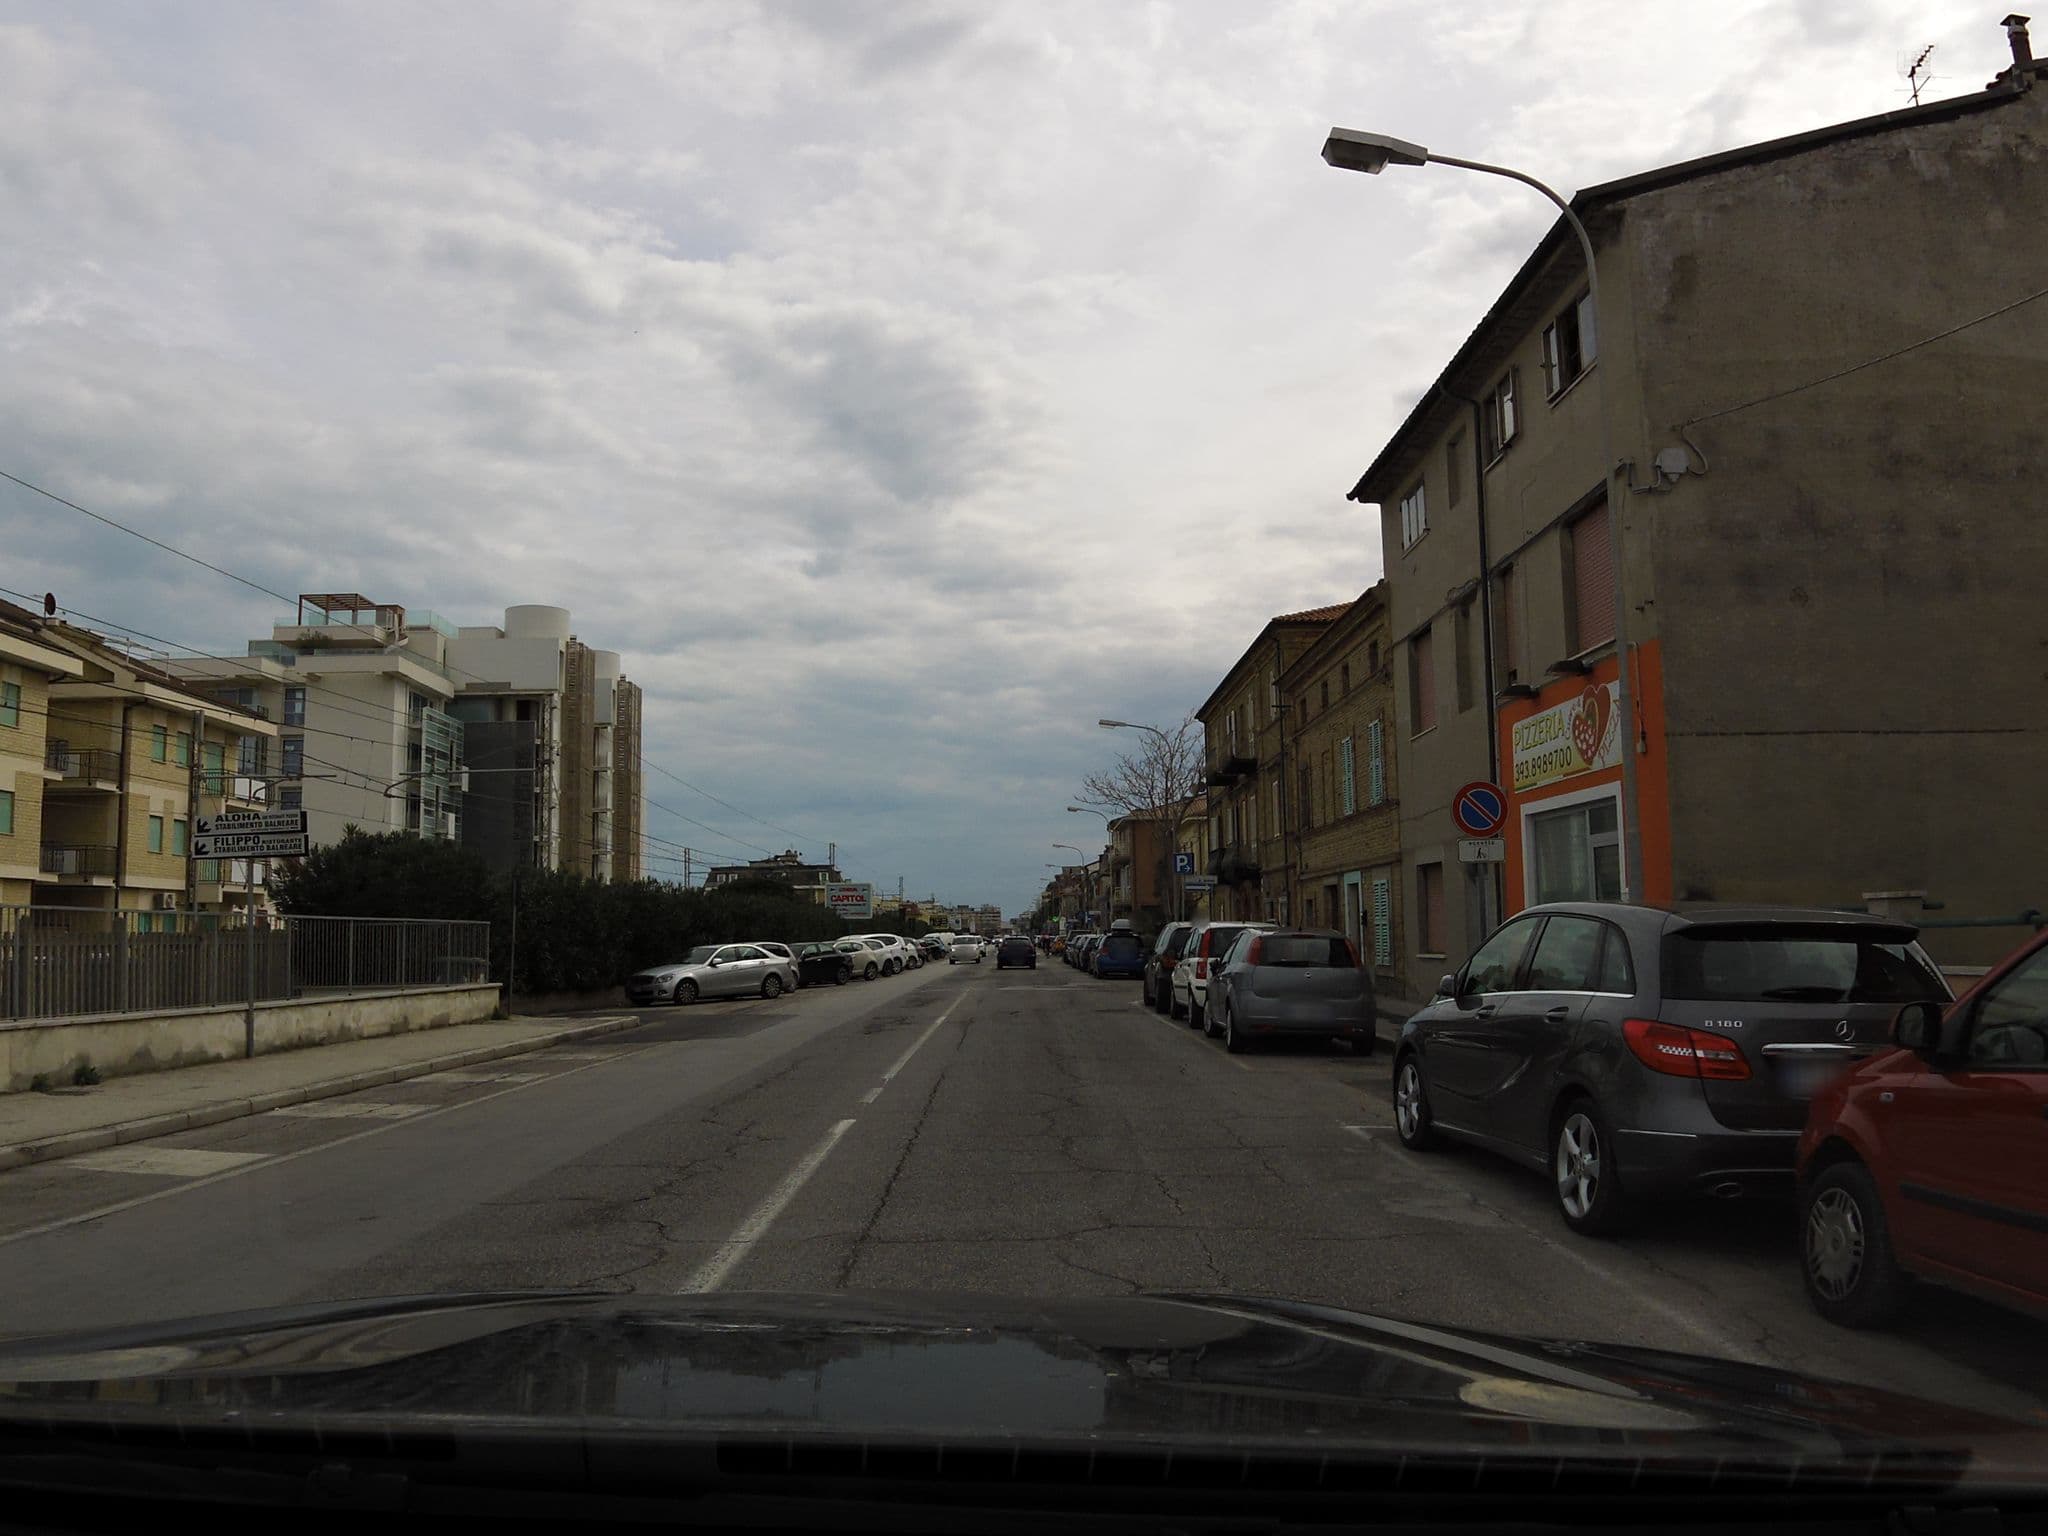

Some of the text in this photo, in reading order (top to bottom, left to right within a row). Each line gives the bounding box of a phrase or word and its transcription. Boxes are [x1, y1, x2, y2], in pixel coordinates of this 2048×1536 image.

[1514, 709, 1565, 753] PIZZERIA
[1515, 745, 1572, 782] 393.8989700
[215, 813, 261, 823] ALOHA
[215, 821, 263, 831] STABILIMENTO
[264, 819, 299, 828] BALNEARE
[213, 835, 260, 846] FILIPPO
[213, 845, 264, 854] STABILIMENTO
[266, 843, 302, 851] BALNEARE
